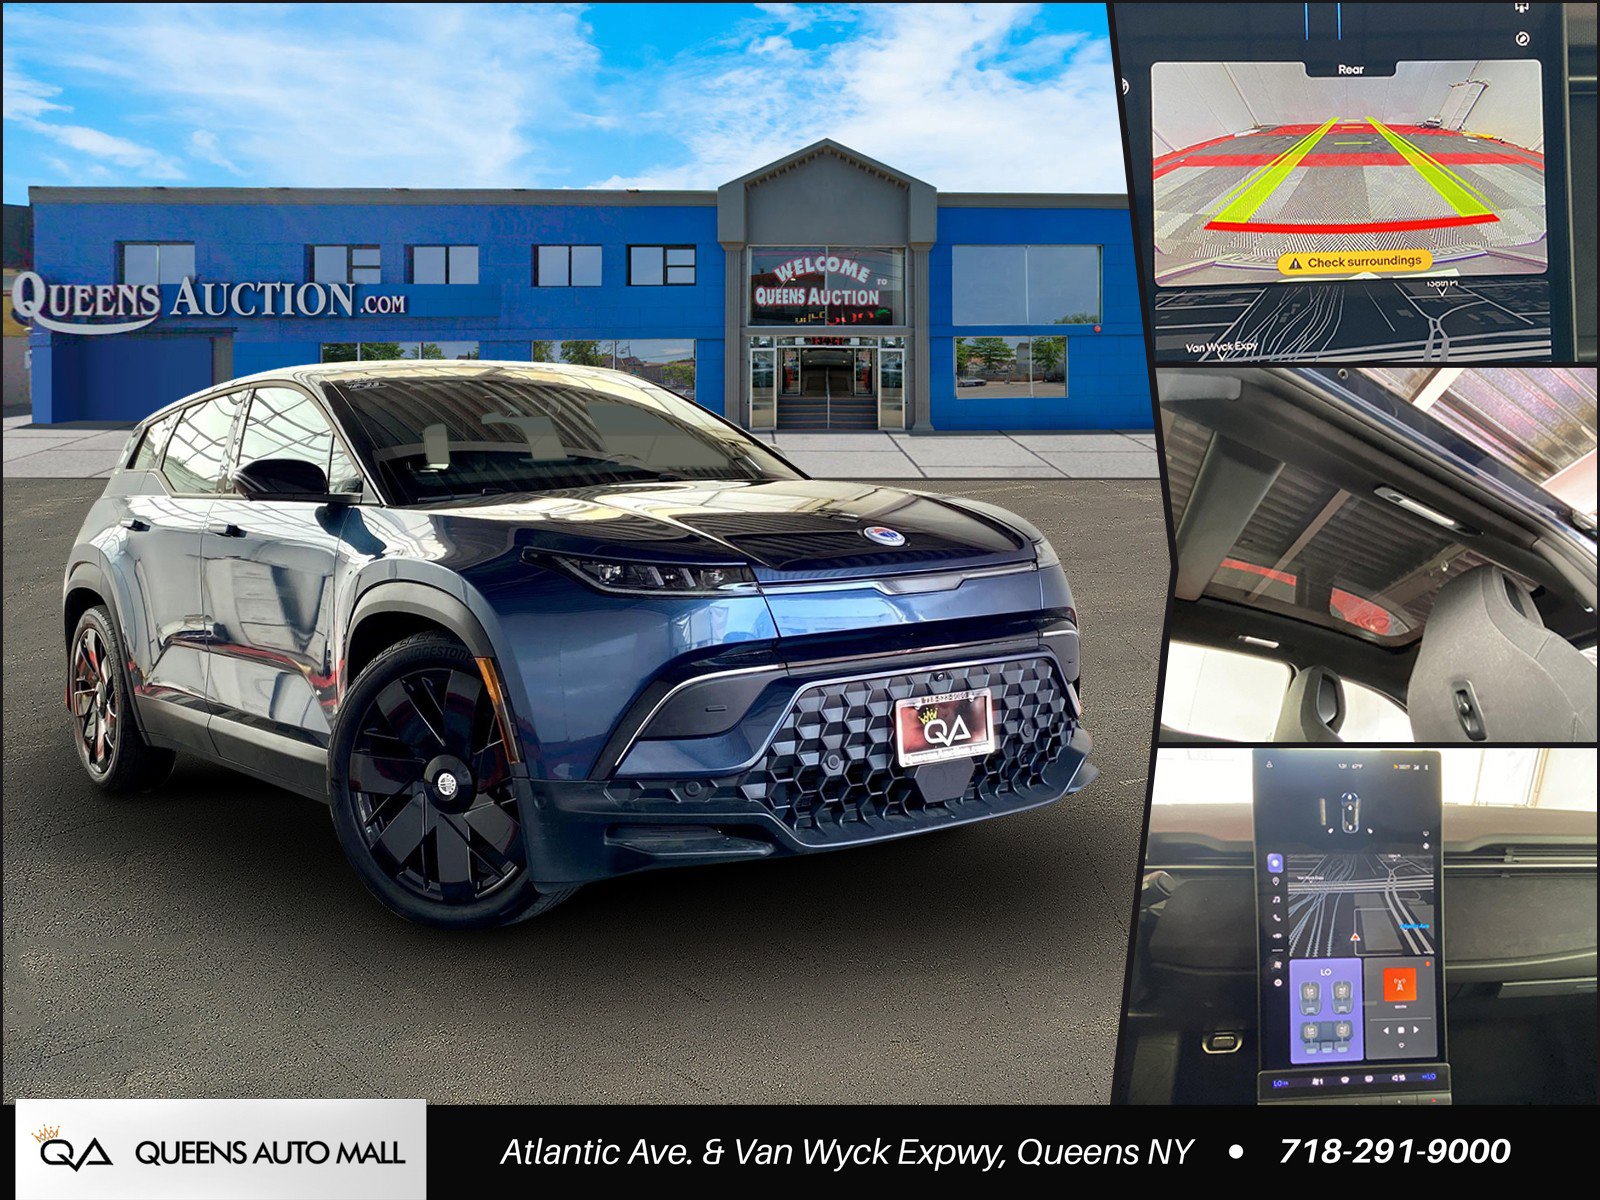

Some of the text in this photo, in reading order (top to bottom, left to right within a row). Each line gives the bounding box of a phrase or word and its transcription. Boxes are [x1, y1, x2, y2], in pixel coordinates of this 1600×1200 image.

[1338, 64, 1365, 76] Rear
[1307, 255, 1422, 268] Check surroundings
[773, 256, 871, 284] WELCOME
[754, 286, 880, 306] QUEENS AUCTION
[11, 271, 161, 335] QUEENS
[1185, 341, 1259, 353] Van Wyck Expy
[1320, 968, 1332, 976] LO
